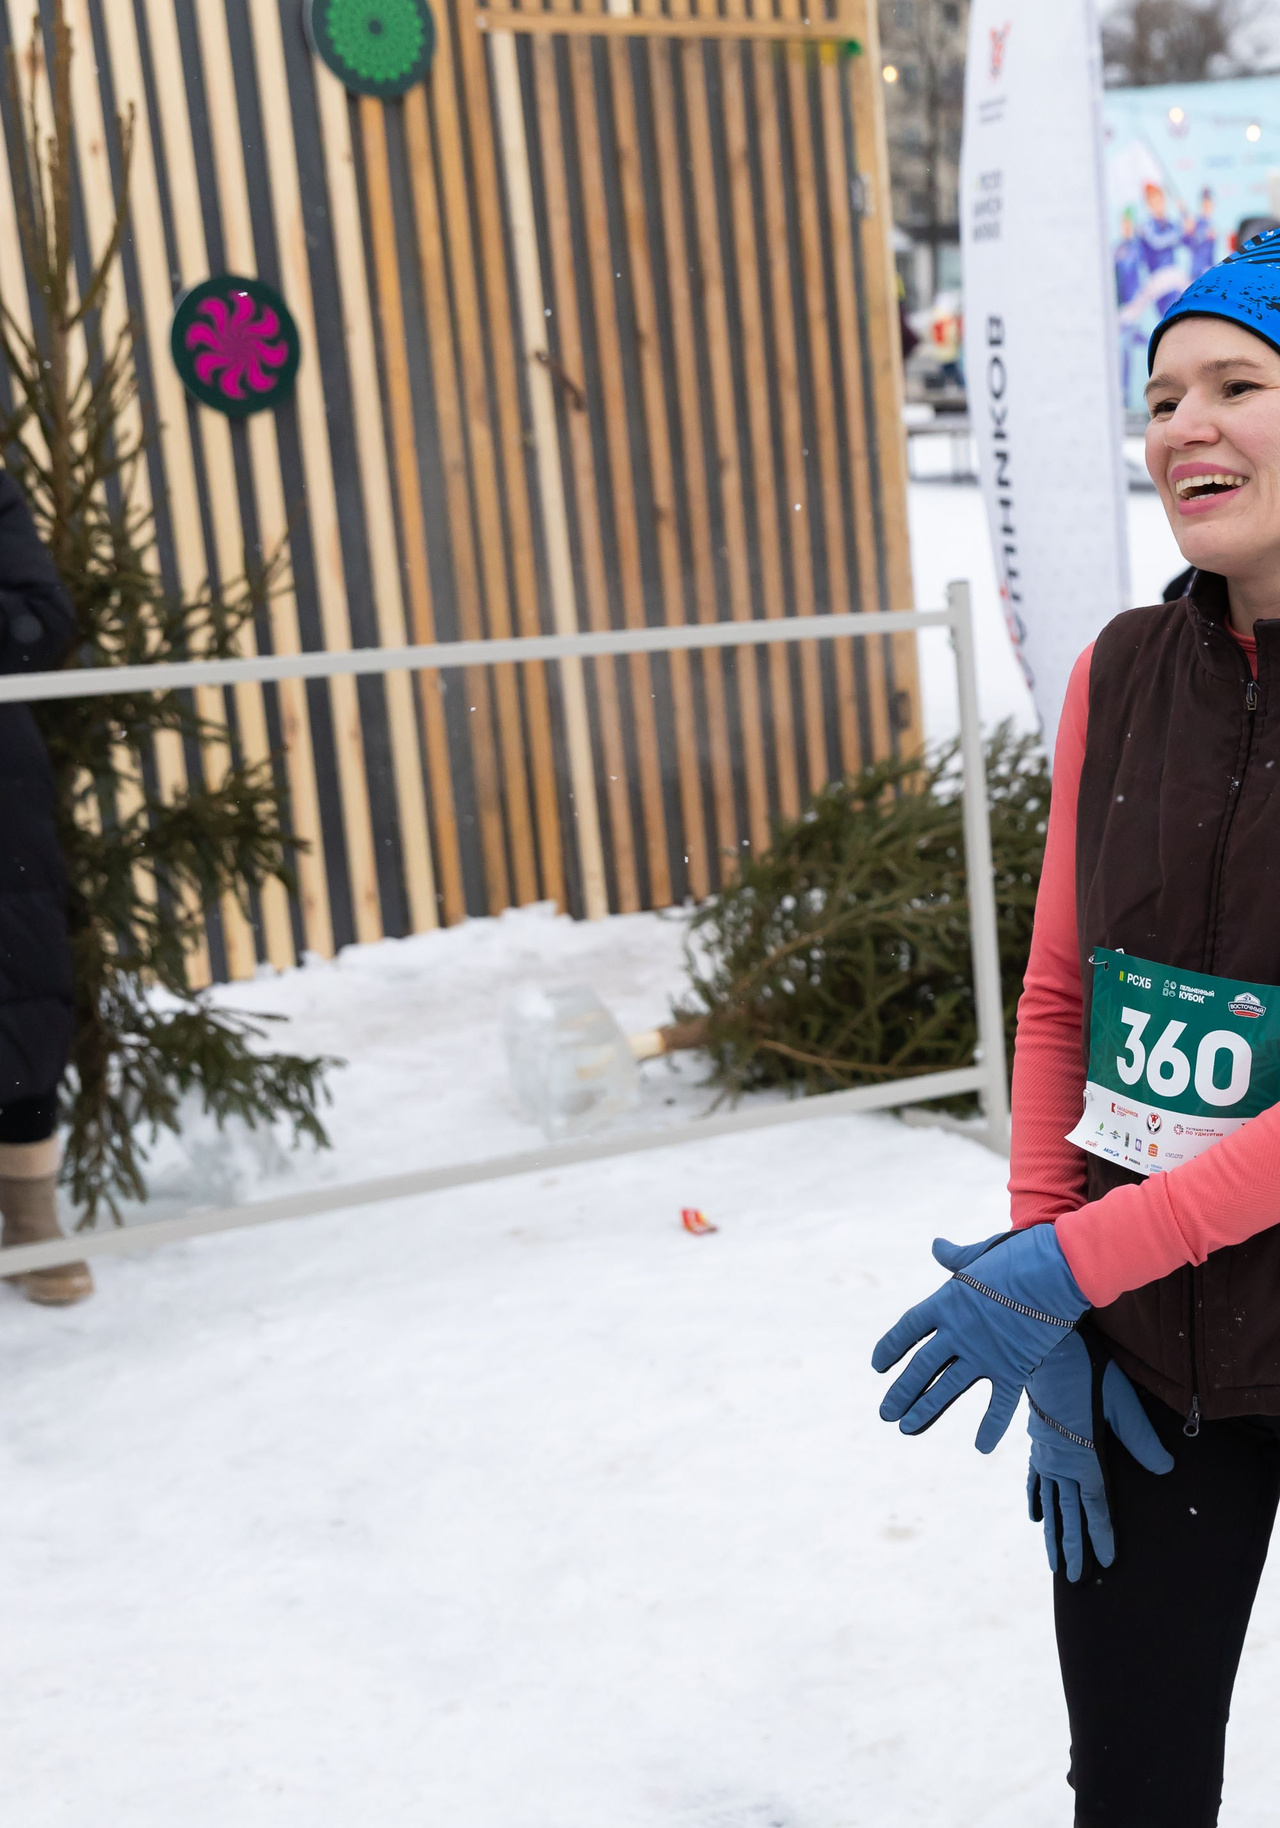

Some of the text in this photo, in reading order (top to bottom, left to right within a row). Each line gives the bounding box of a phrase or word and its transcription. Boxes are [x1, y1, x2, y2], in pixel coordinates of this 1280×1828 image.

[1126, 973, 1152, 989] РСХБ
[1179, 984, 1215, 997] ПЕЛЬМЕННЫЙ
[1178, 991, 1205, 1004] КУБОК
[1229, 1003, 1265, 1014] ВОСТОЧНЫЙ
[1116, 1006, 1252, 1106] 360
